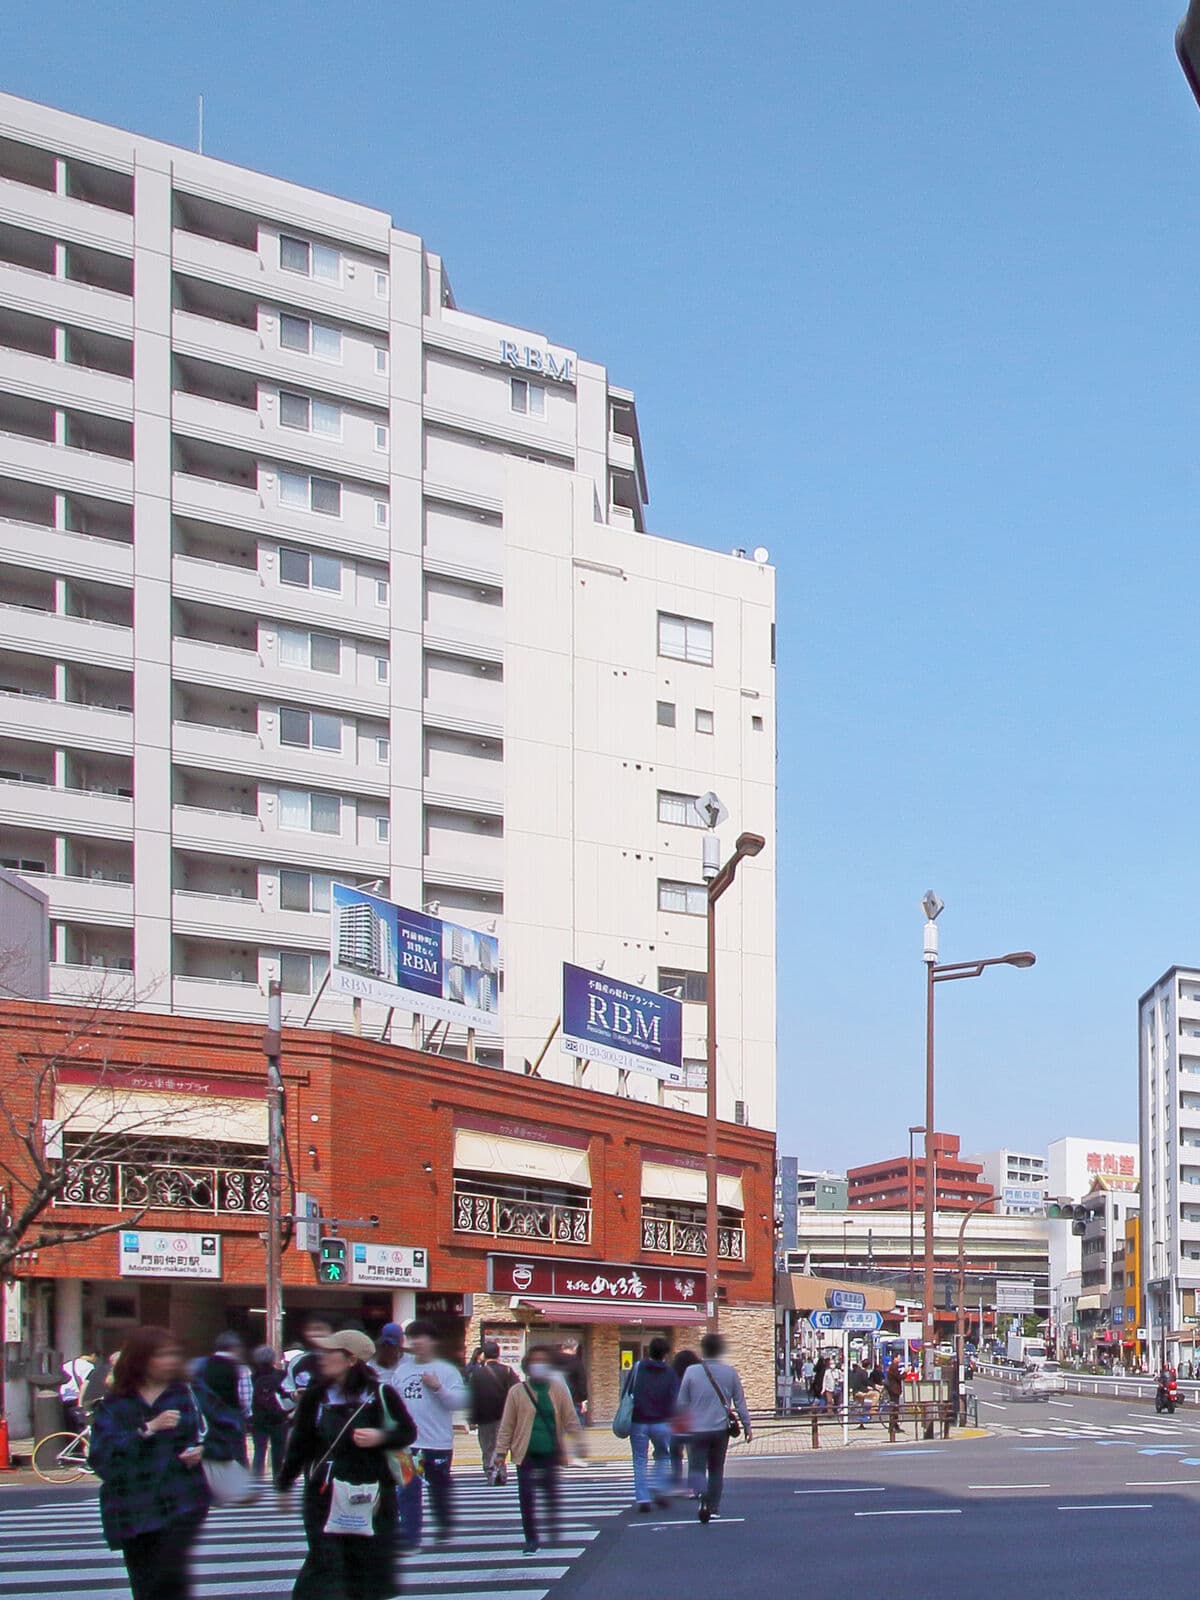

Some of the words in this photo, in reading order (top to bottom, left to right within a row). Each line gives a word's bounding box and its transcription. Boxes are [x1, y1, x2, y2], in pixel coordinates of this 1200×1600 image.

[499, 339, 573, 380] RBM
[402, 951, 439, 976] RBM
[340, 975, 374, 996] RBM
[586, 993, 662, 1045] RBM
[141, 1254, 200, 1266] 門前仲町駅
[367, 1264, 413, 1277] 門前仲町駅
